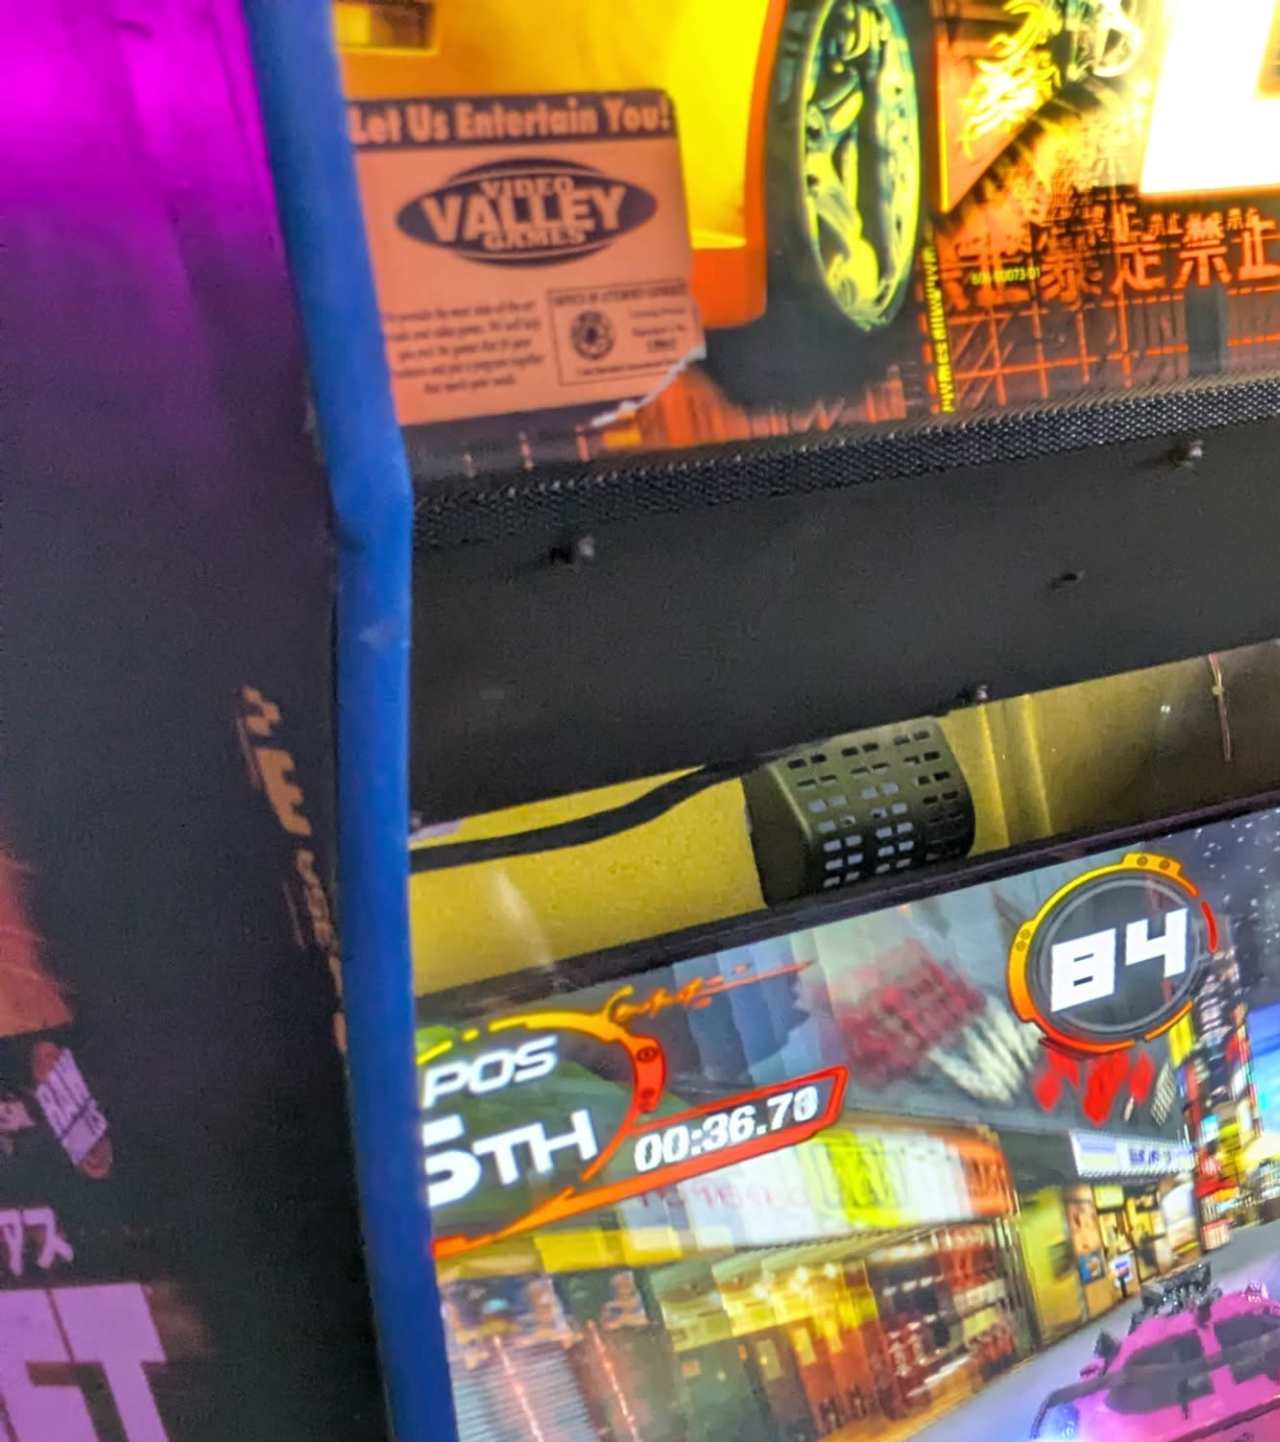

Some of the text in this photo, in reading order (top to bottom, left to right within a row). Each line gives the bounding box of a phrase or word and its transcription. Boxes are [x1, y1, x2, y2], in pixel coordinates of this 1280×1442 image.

[351, 94, 670, 144] Let Us Entertain You!
[419, 185, 628, 243] VALLEY
[479, 174, 575, 199] VIDEO
[482, 227, 588, 251] GAMES
[1049, 907, 1189, 1013] 84
[420, 1034, 557, 1108] POS
[422, 1110, 598, 1209] 5TH
